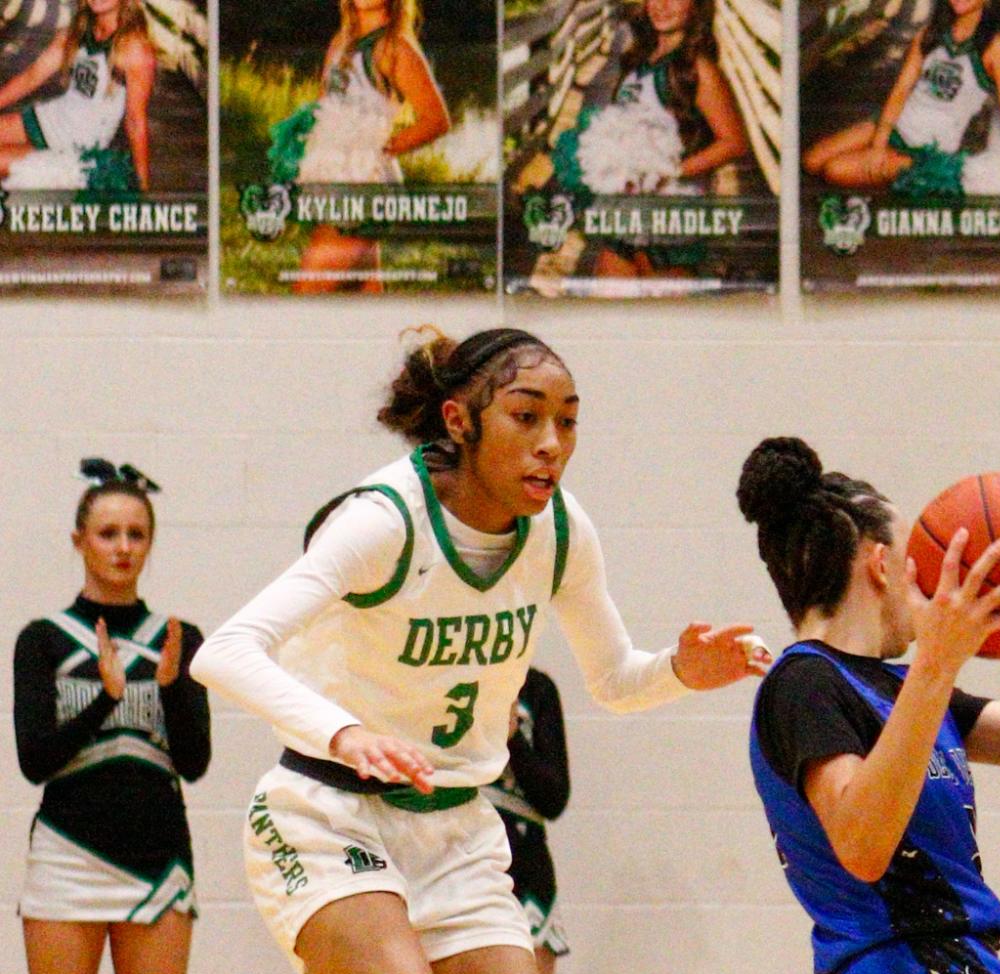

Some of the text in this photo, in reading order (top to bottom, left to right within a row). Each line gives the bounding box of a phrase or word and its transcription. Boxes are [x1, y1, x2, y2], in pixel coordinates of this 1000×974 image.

[10, 203, 199, 233] KEELEY CHANCE
[297, 195, 468, 222] KYLIN CORNEJO
[584, 208, 742, 235] ELLA HADLEY
[877, 208, 954, 236] GIANNA
[398, 604, 538, 667] DERBY
[431, 680, 480, 749] 3
